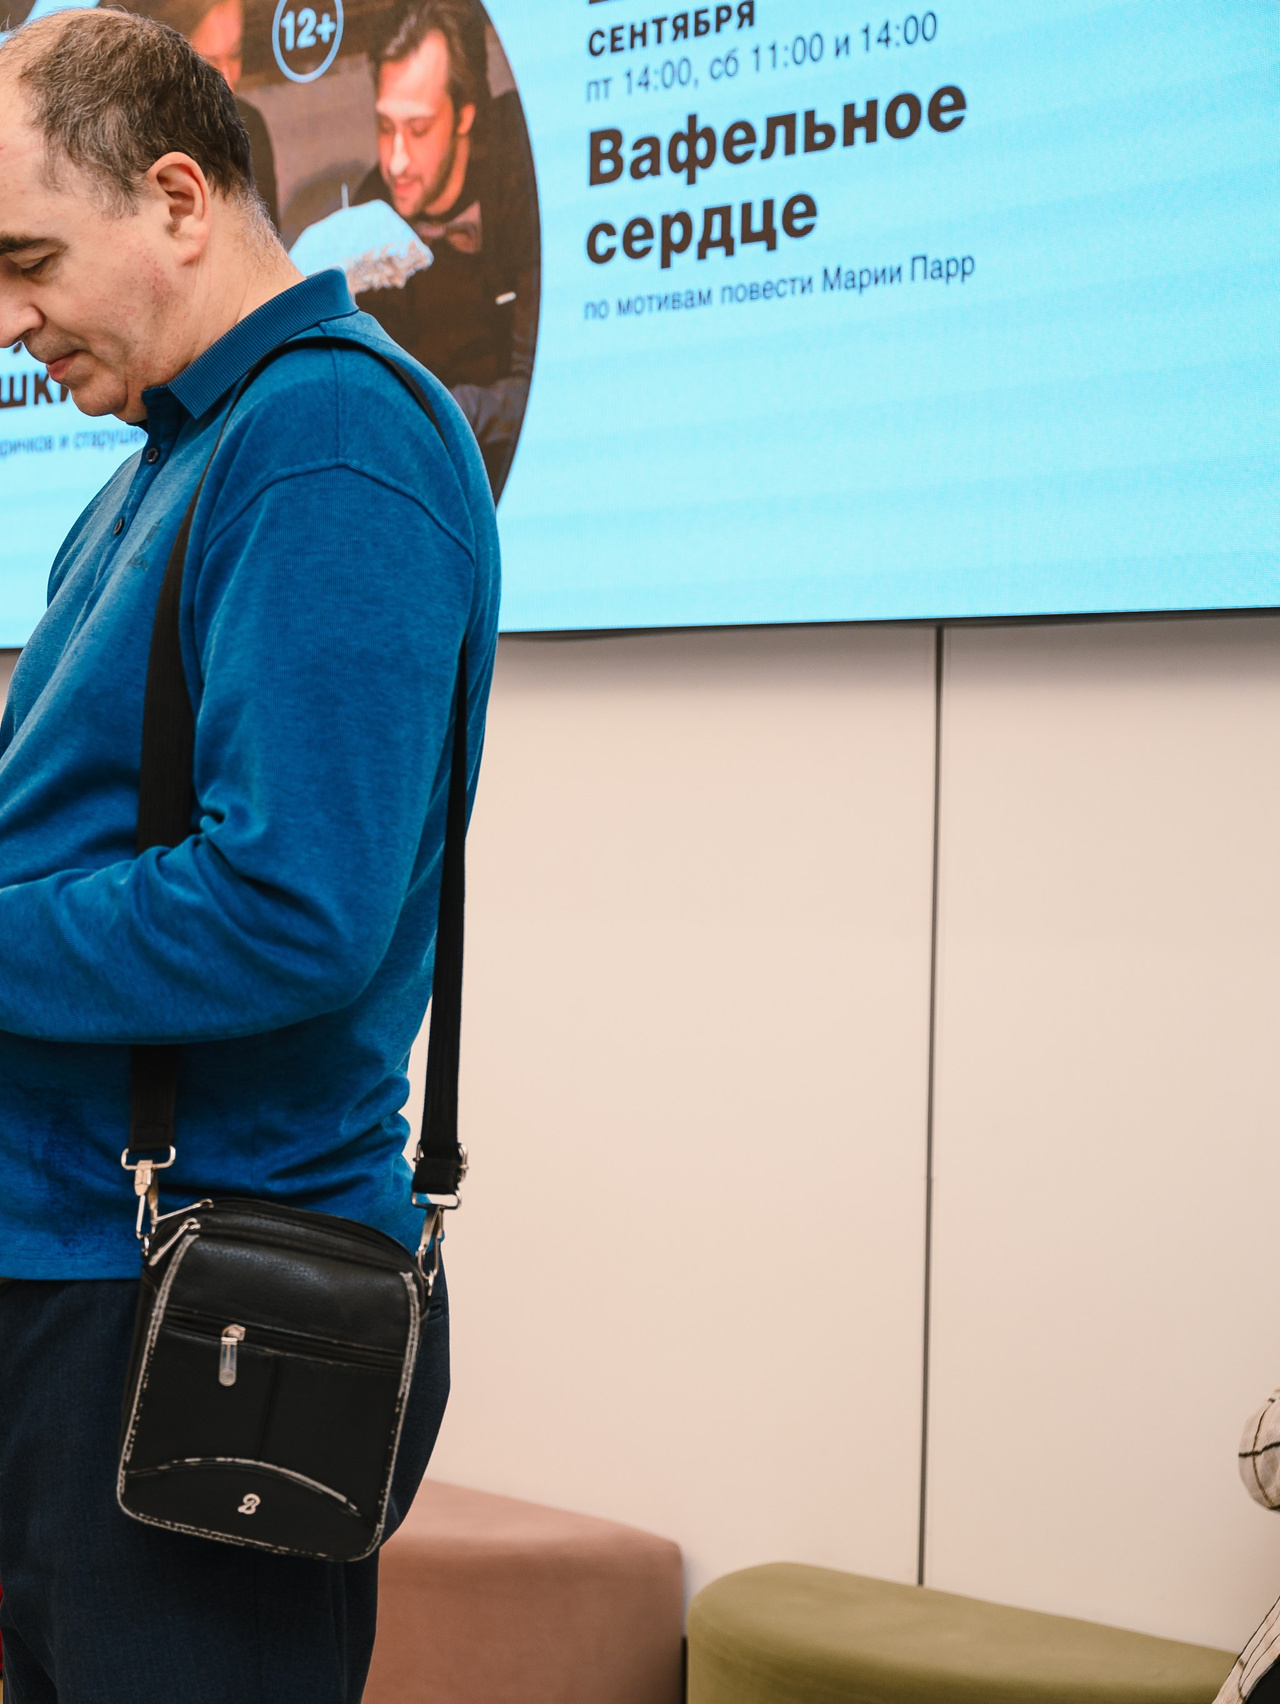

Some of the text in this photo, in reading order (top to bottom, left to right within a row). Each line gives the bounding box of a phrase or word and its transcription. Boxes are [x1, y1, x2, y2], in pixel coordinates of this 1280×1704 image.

[281, 8, 336, 51] 12+
[587, 12, 938, 102] пт 14:00, сб 11:00 и 14:00
[588, 1, 756, 57] СЕНТЯБРЯ
[589, 84, 967, 187] Вафельное
[586, 193, 818, 270] сердце
[584, 254, 976, 320] по мотивам повести Марии Парр
